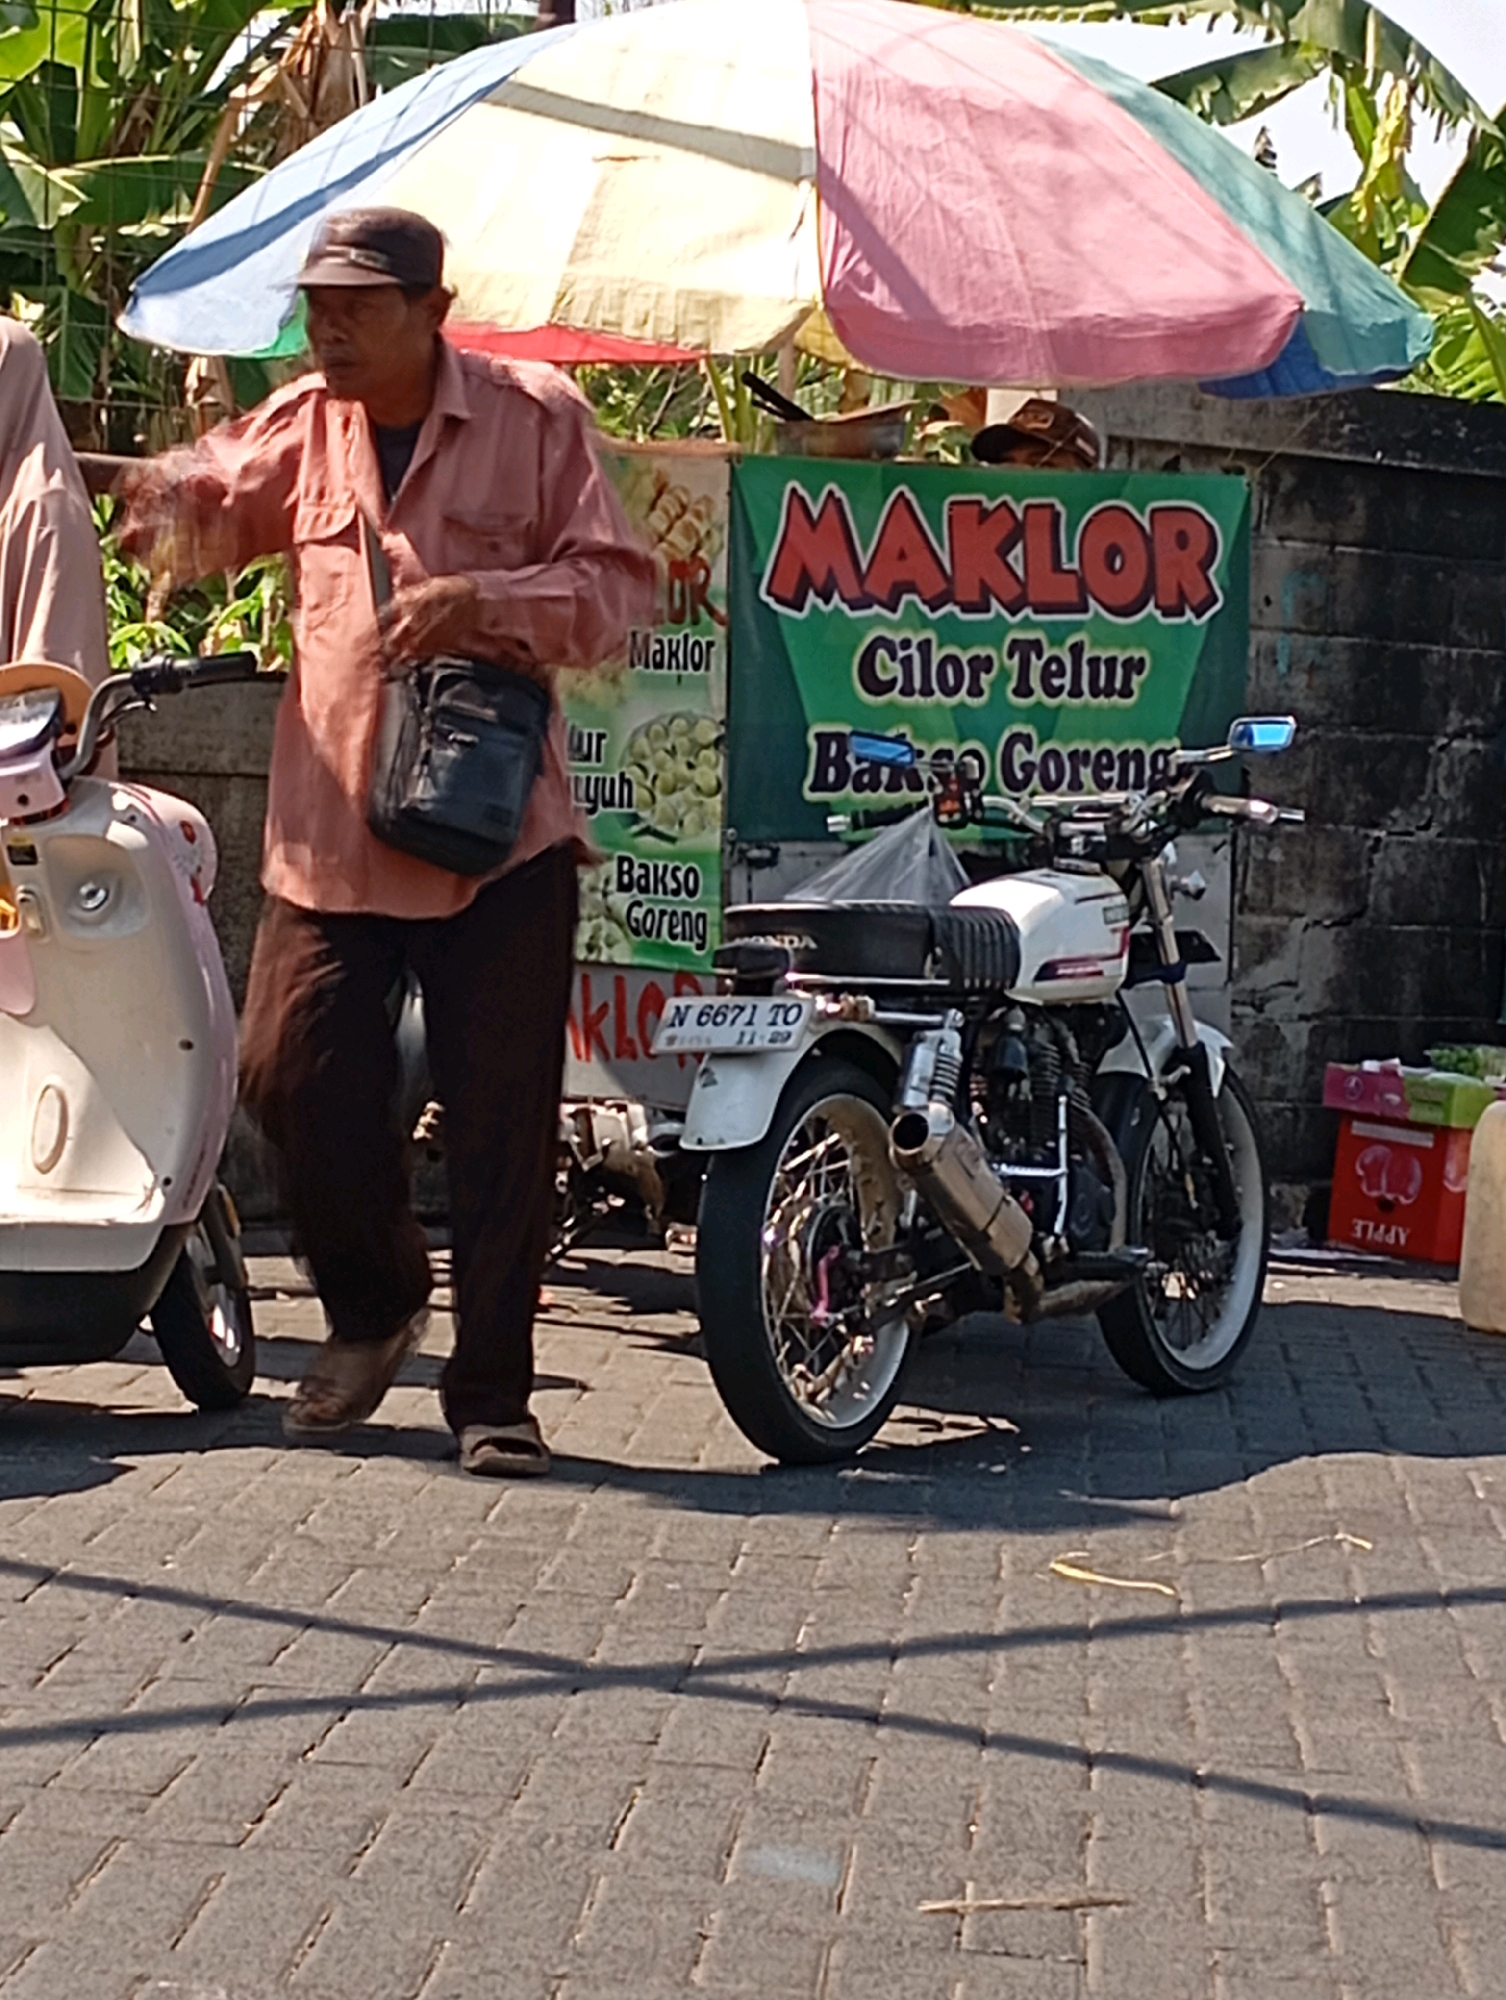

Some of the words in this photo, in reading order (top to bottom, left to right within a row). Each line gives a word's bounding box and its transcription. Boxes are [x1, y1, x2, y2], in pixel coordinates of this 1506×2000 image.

[763, 483, 1222, 622] MAKLOR
[629, 631, 715, 673] Maklor
[856, 634, 995, 699] Cilor
[1006, 636, 1146, 699] Telur
[616, 855, 700, 899] Bakso
[626, 900, 708, 952] Goreng
[734, 934, 819, 950] ONDA
[667, 1005, 693, 1028] N
[696, 1004, 758, 1028] 6671
[767, 1003, 803, 1027] TO
[1350, 1217, 1412, 1247] APPLE
